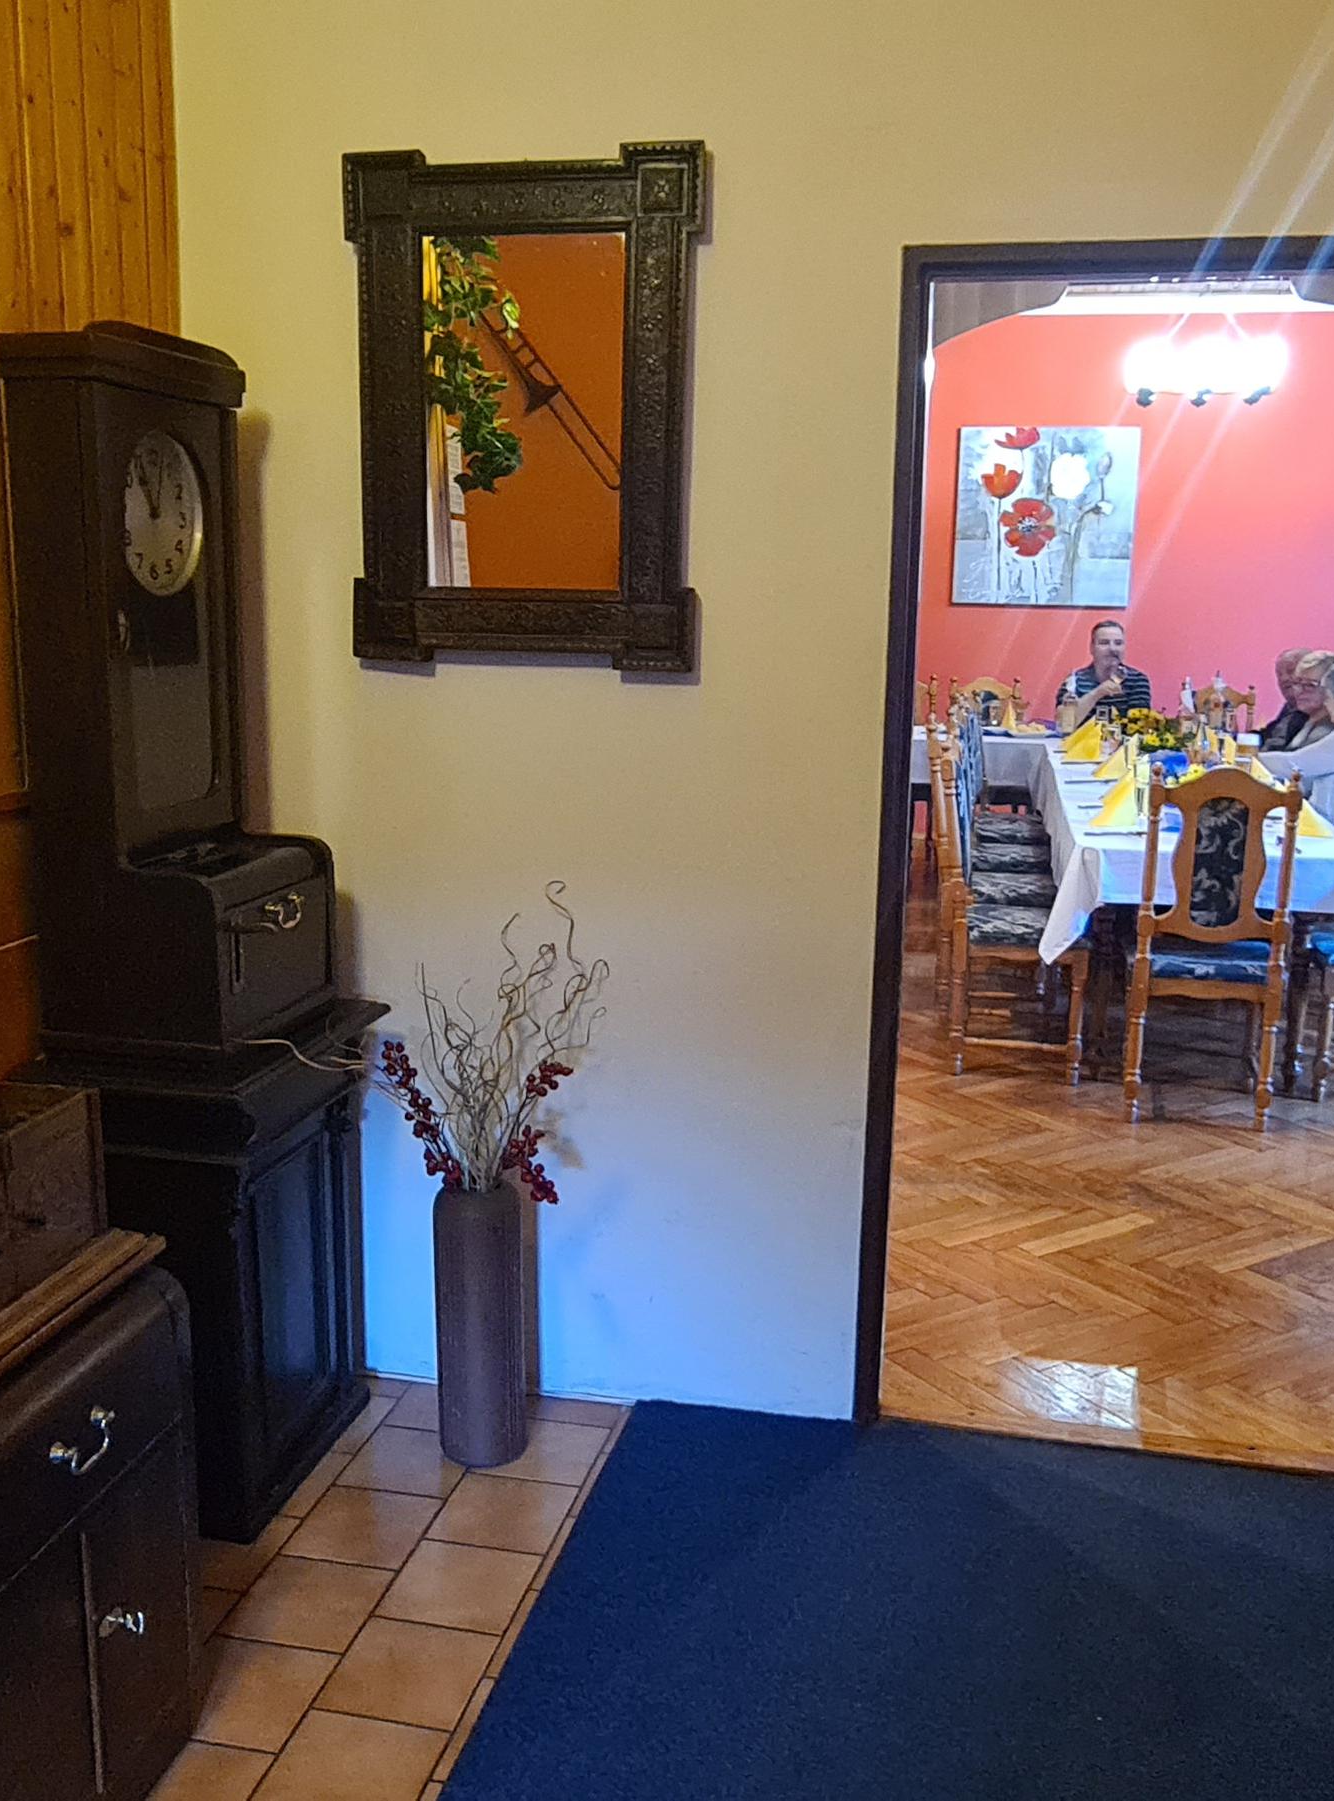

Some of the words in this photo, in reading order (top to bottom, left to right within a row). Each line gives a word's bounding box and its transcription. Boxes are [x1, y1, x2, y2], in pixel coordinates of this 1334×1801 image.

[178, 511, 187, 529] 3
[175, 539, 184, 554] 4
[135, 552, 144, 570] 7
[165, 558, 173, 574] 5
[149, 562, 159, 580] 6
